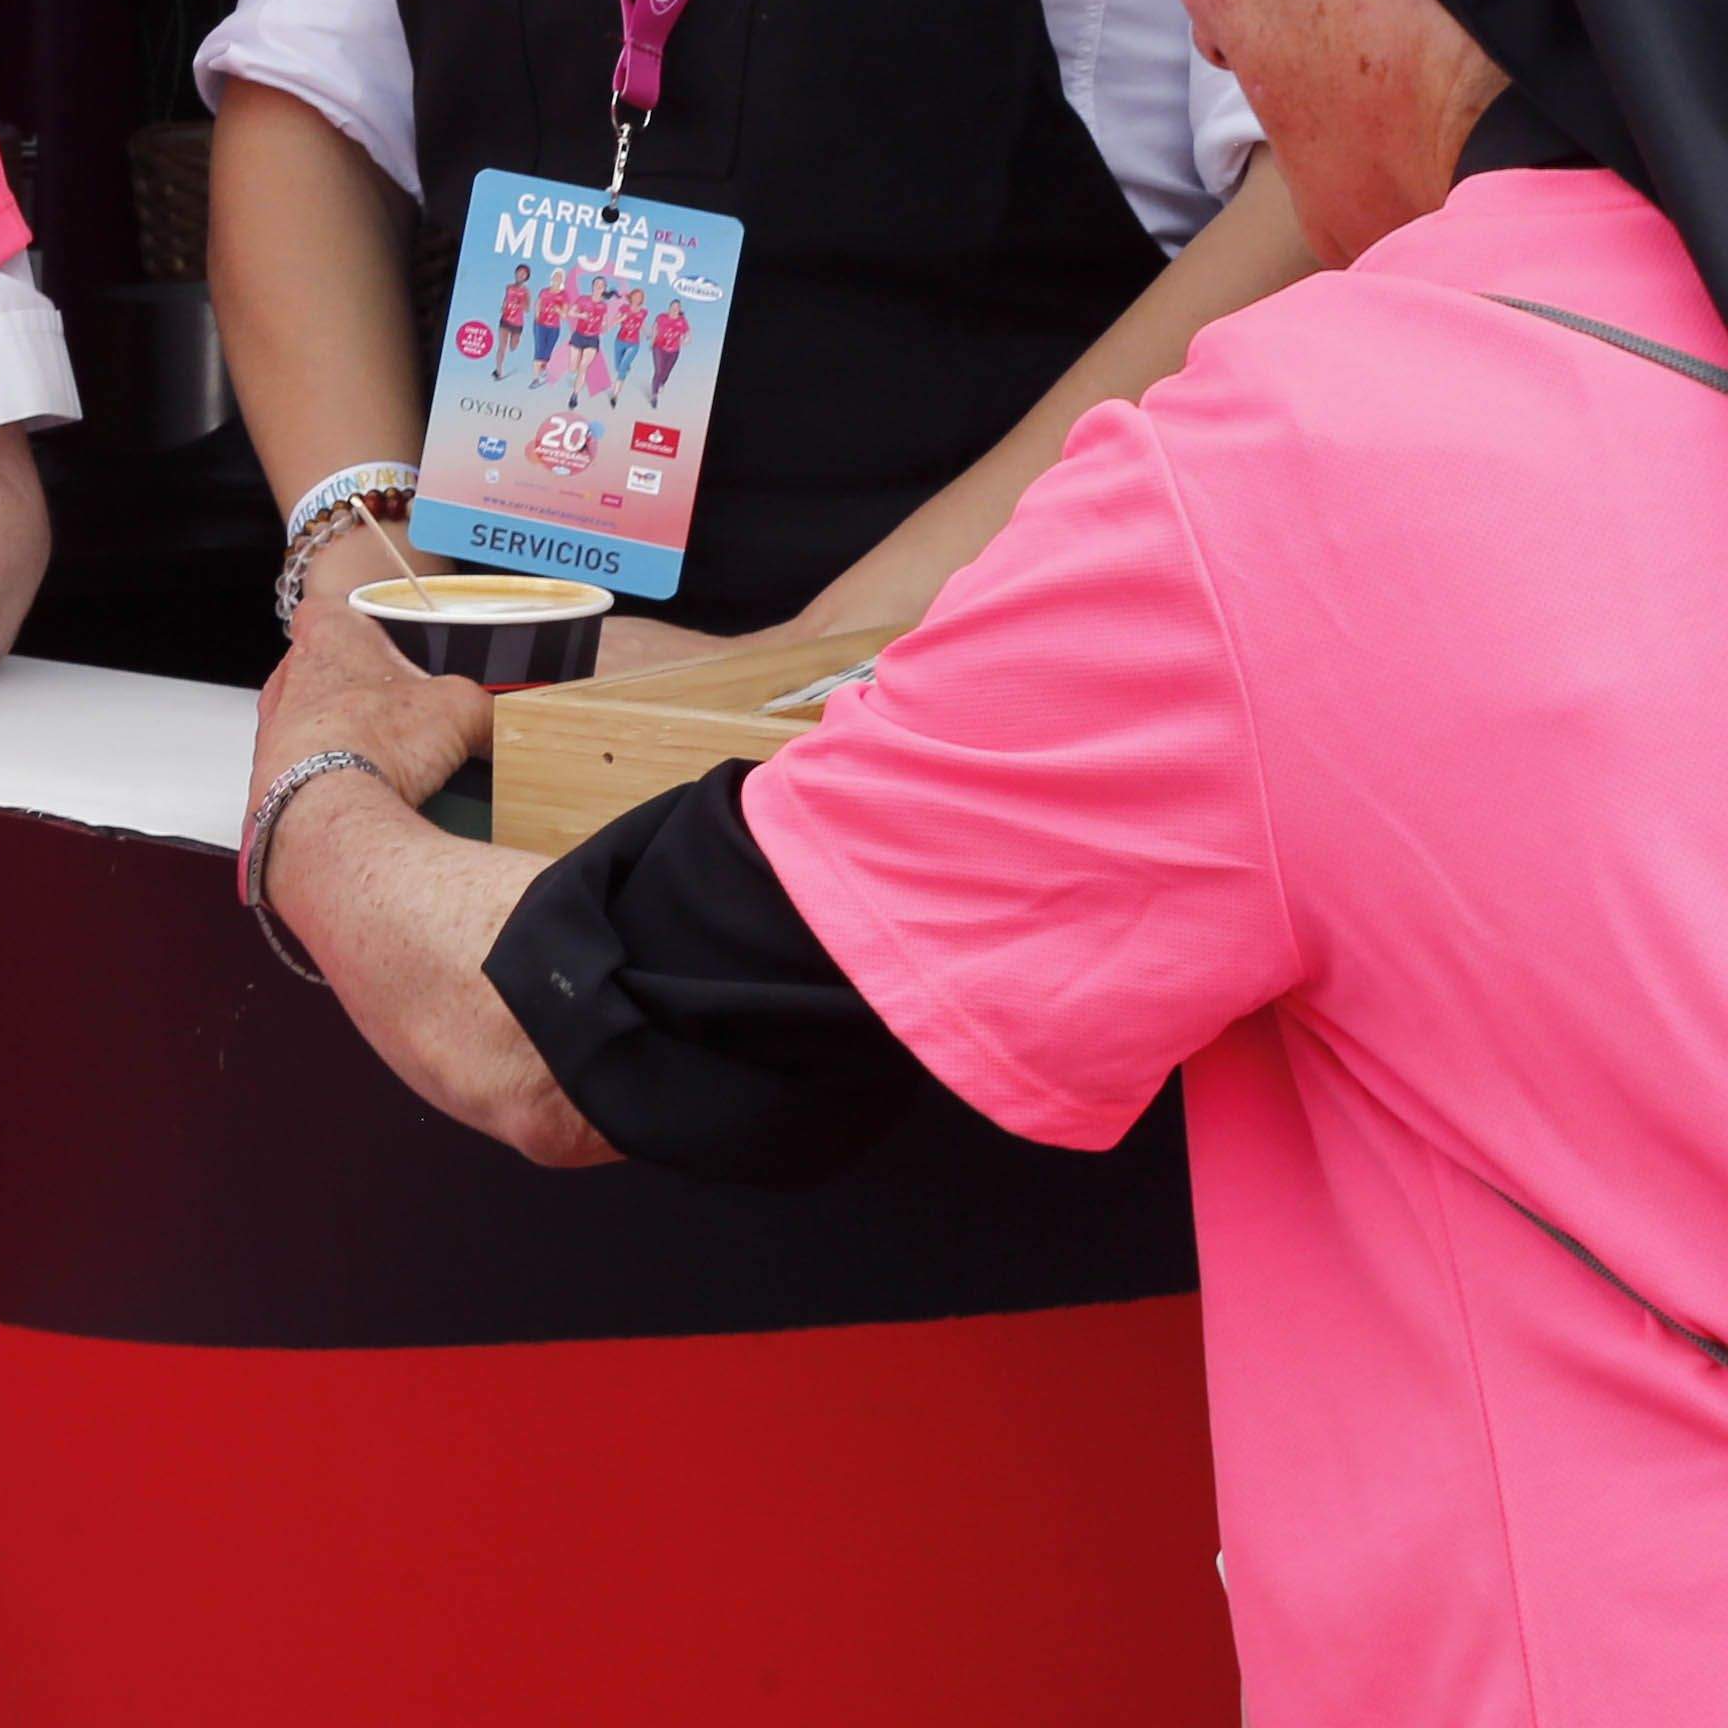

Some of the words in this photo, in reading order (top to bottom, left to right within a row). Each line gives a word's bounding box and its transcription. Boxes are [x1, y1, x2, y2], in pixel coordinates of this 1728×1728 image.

[518, 193, 649, 239] CARRERA
[654, 229, 672, 244] DE
[678, 233, 698, 248] LA
[494, 212, 685, 286] MUJER
[460, 397, 523, 421] OYSHO
[541, 416, 589, 452] 20
[470, 523, 621, 574] SERVICIOS
